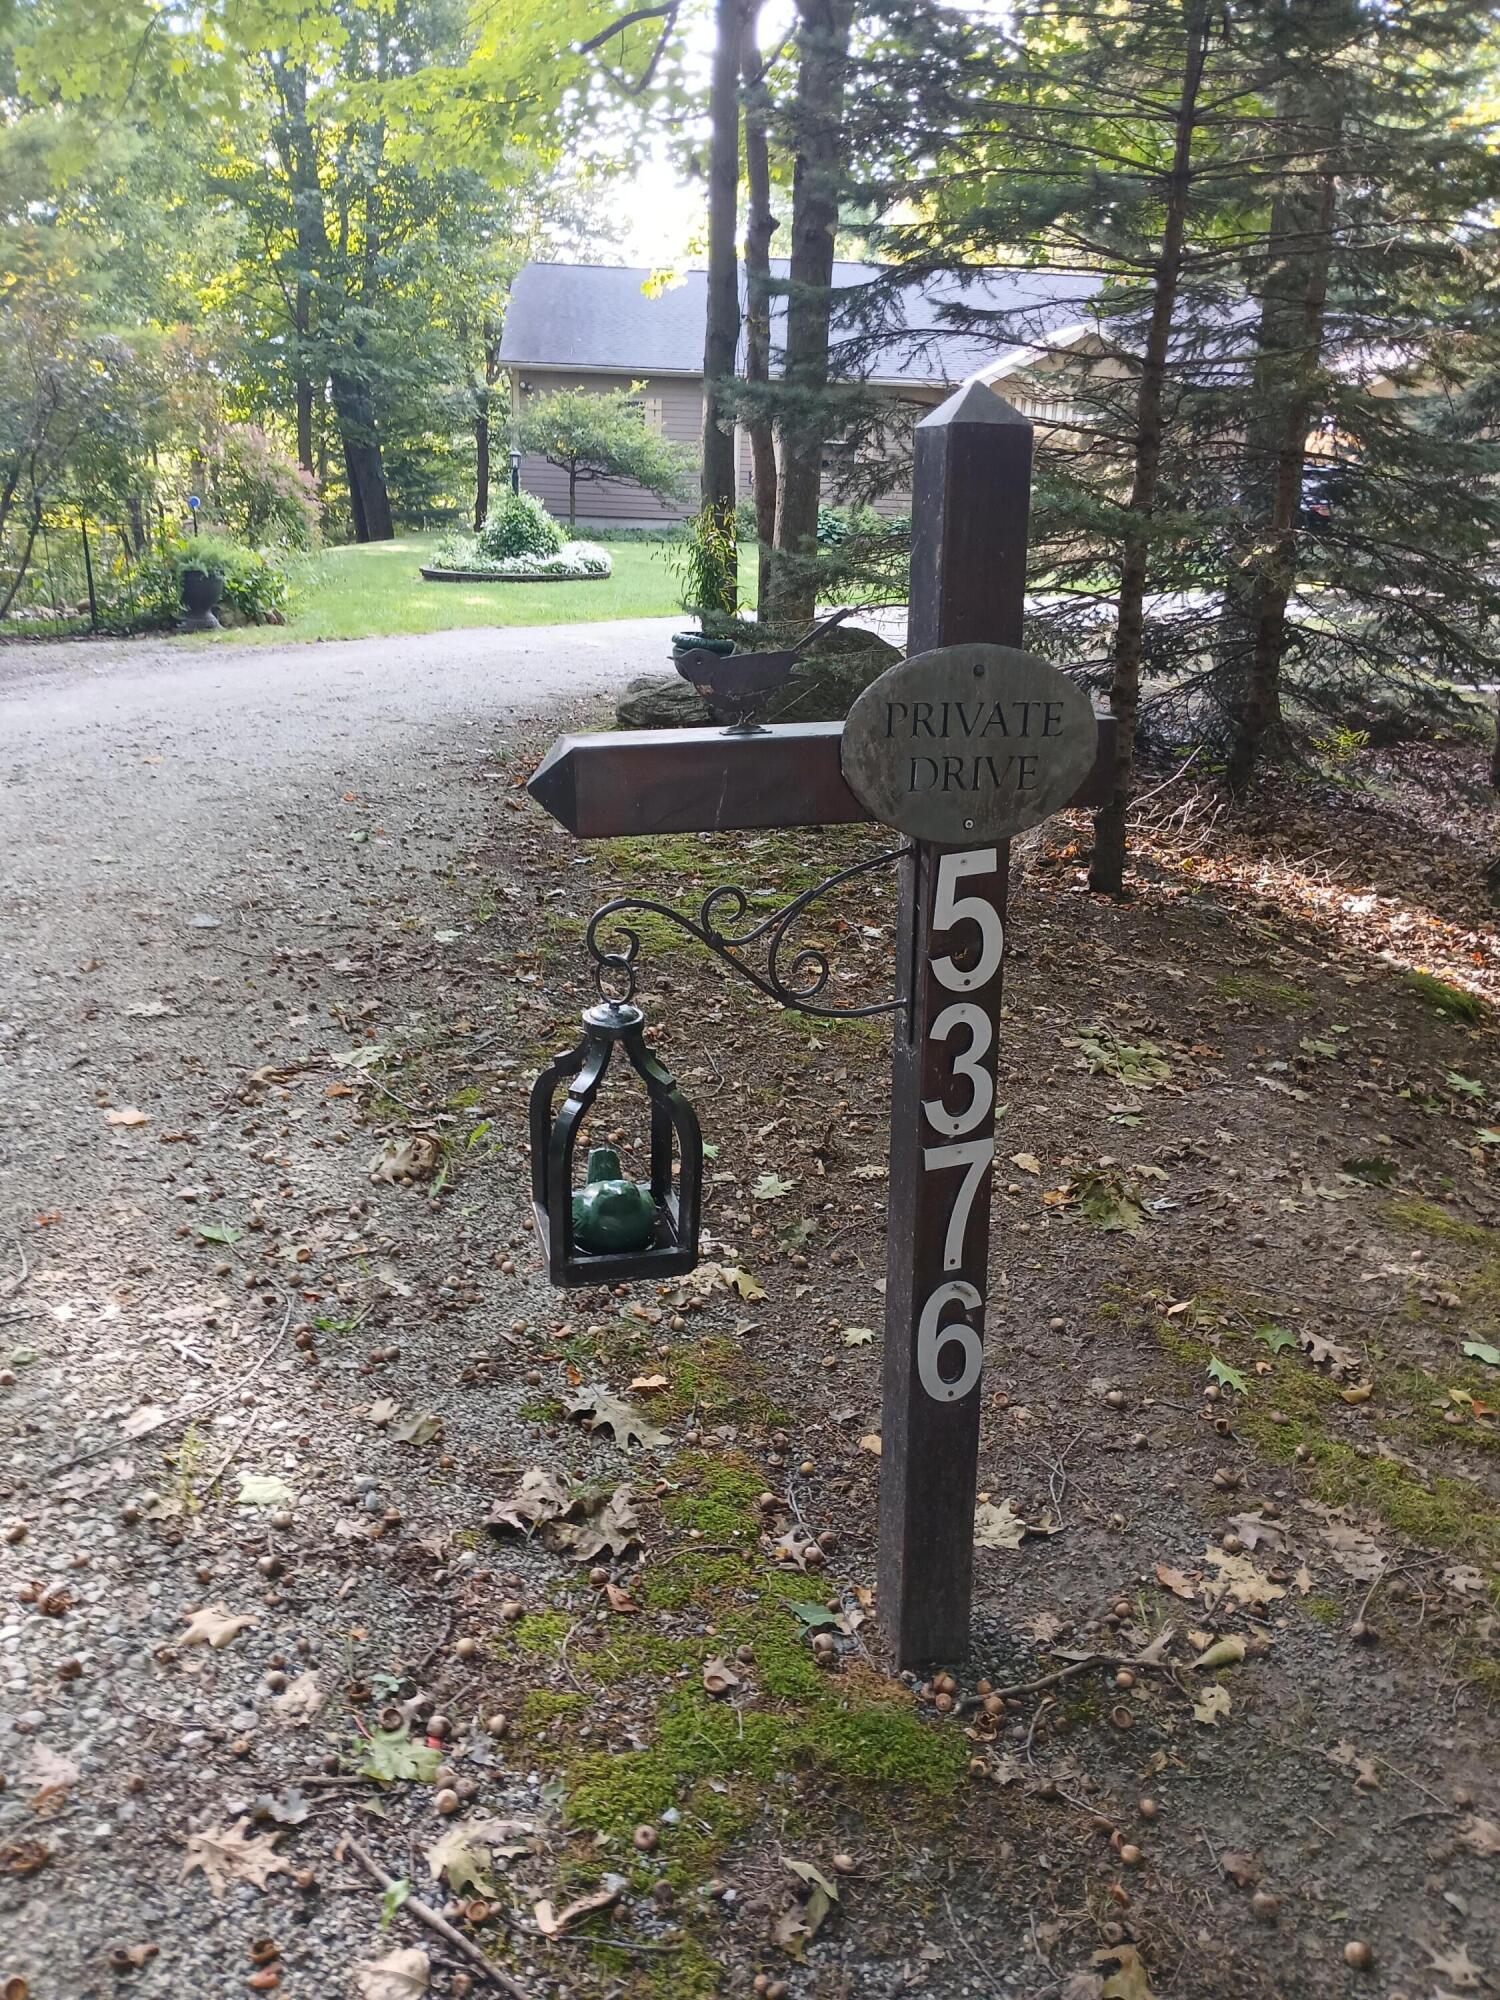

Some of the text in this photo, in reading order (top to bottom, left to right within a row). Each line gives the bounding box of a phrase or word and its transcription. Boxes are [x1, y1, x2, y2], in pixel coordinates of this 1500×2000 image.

[884, 701, 1064, 739] PRIVATE
[908, 755, 1039, 793] DRIVE
[917, 847, 1004, 1402] 5376
